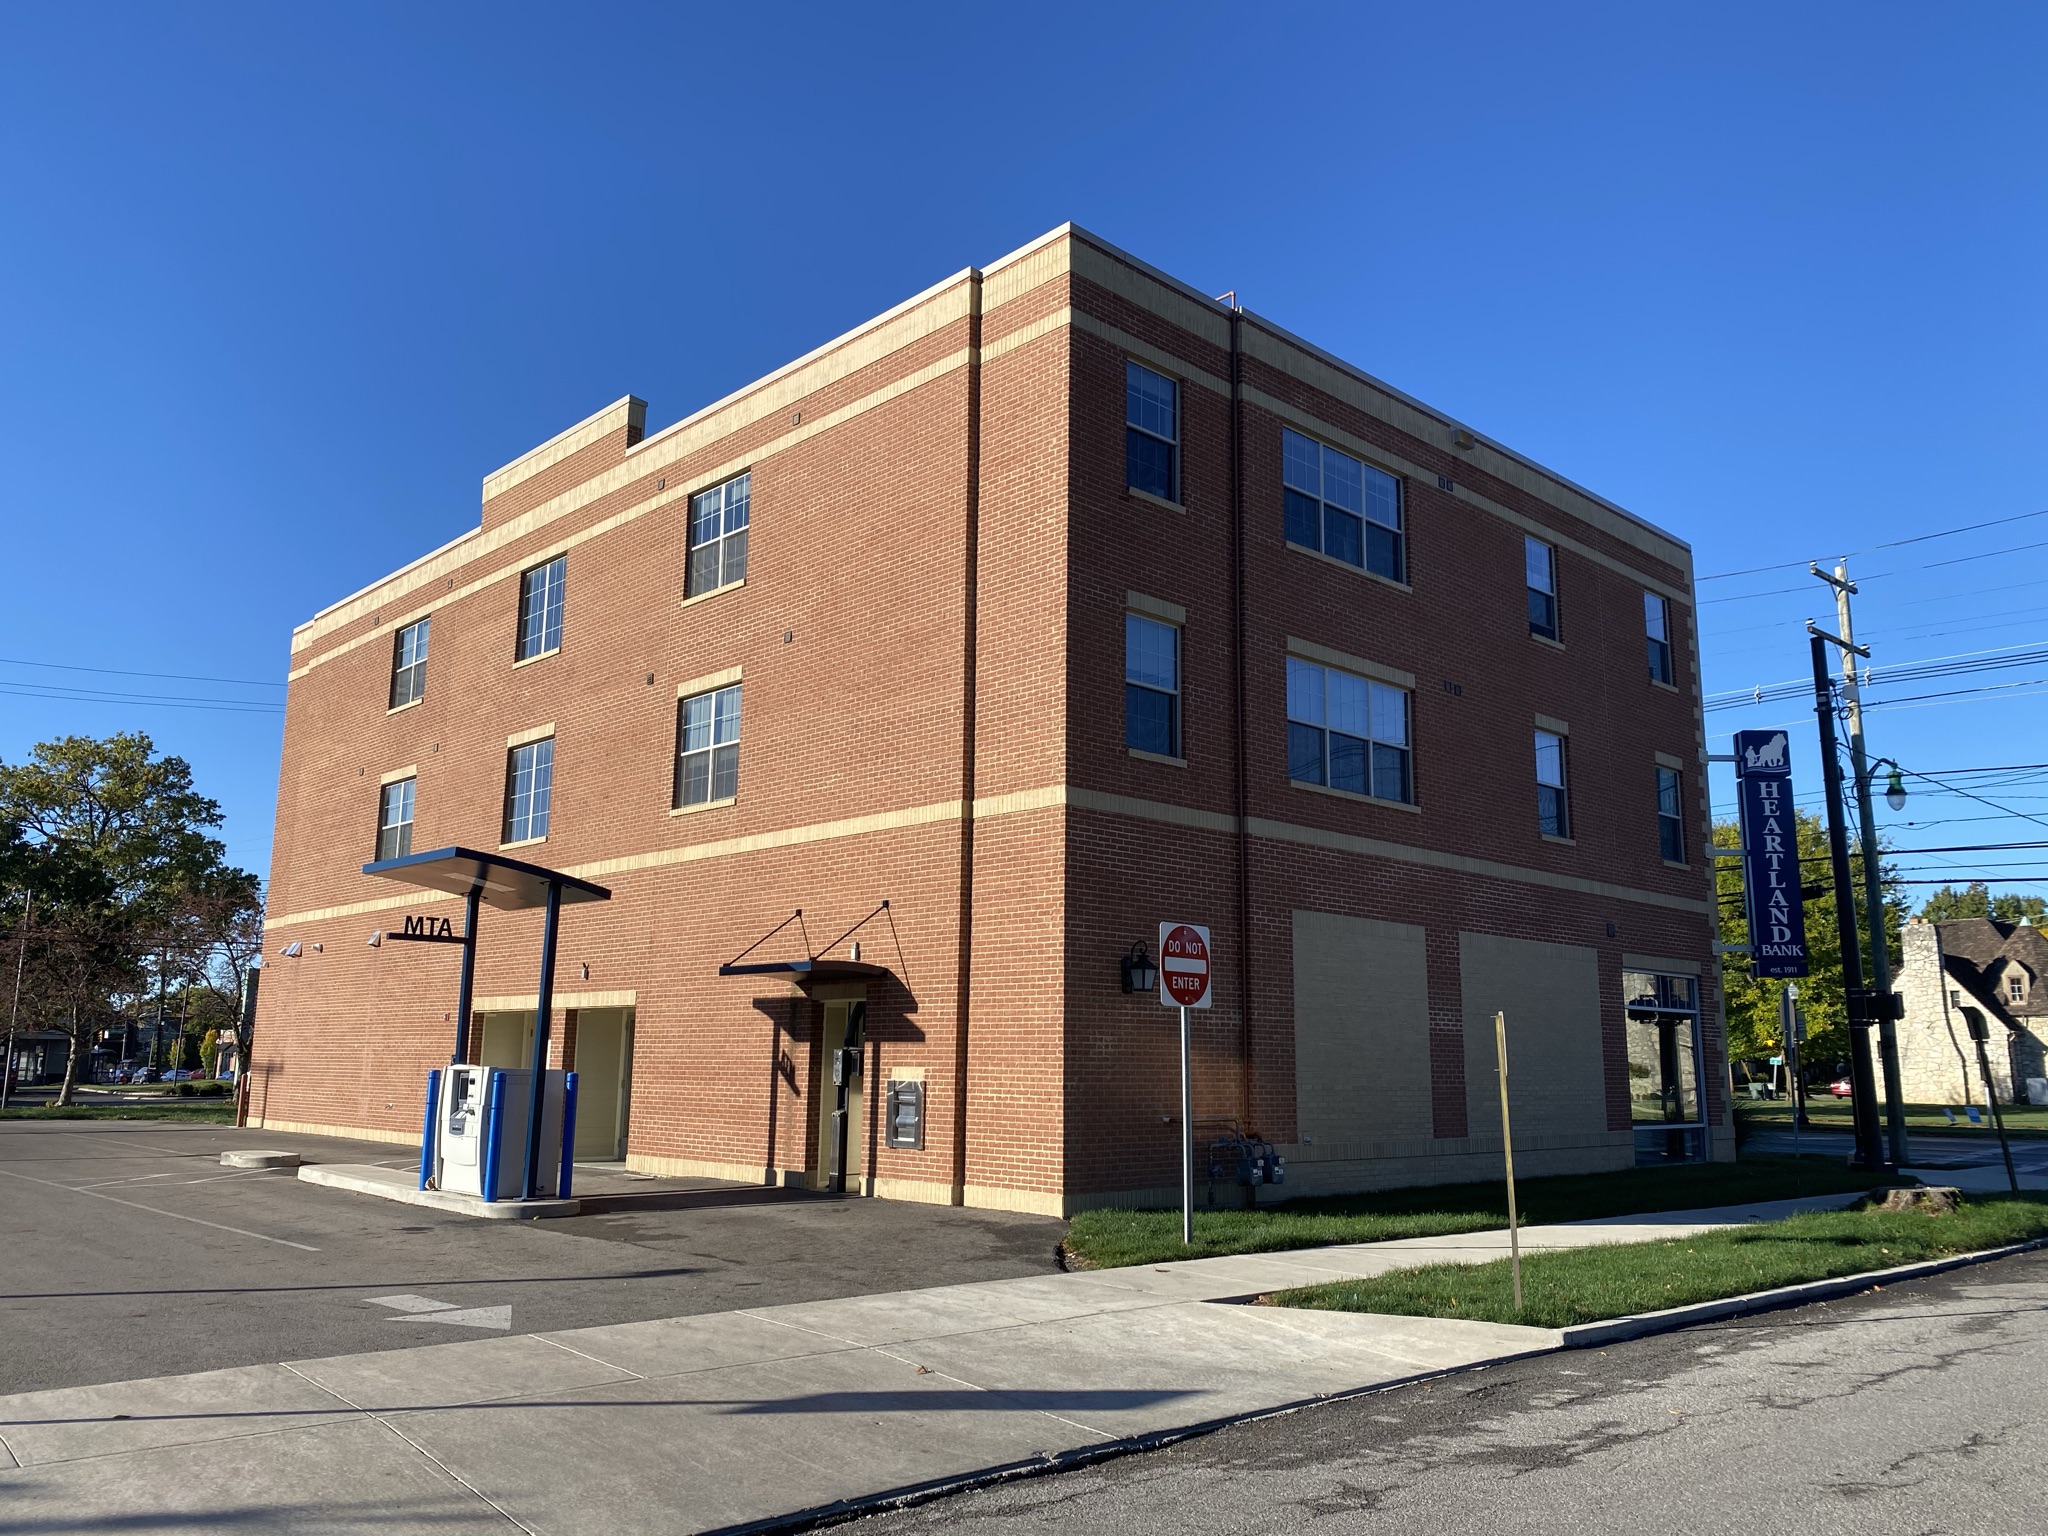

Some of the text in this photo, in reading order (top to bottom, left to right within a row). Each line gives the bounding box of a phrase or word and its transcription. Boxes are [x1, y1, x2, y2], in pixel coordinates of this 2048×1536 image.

[1758, 781, 1792, 943] HEARTLAND
[1168, 940, 1202, 955] DO NOT
[1761, 944, 1804, 956] BANK
[1770, 966, 1798, 974] est. 1911
[1172, 976, 1200, 990] ENTER
